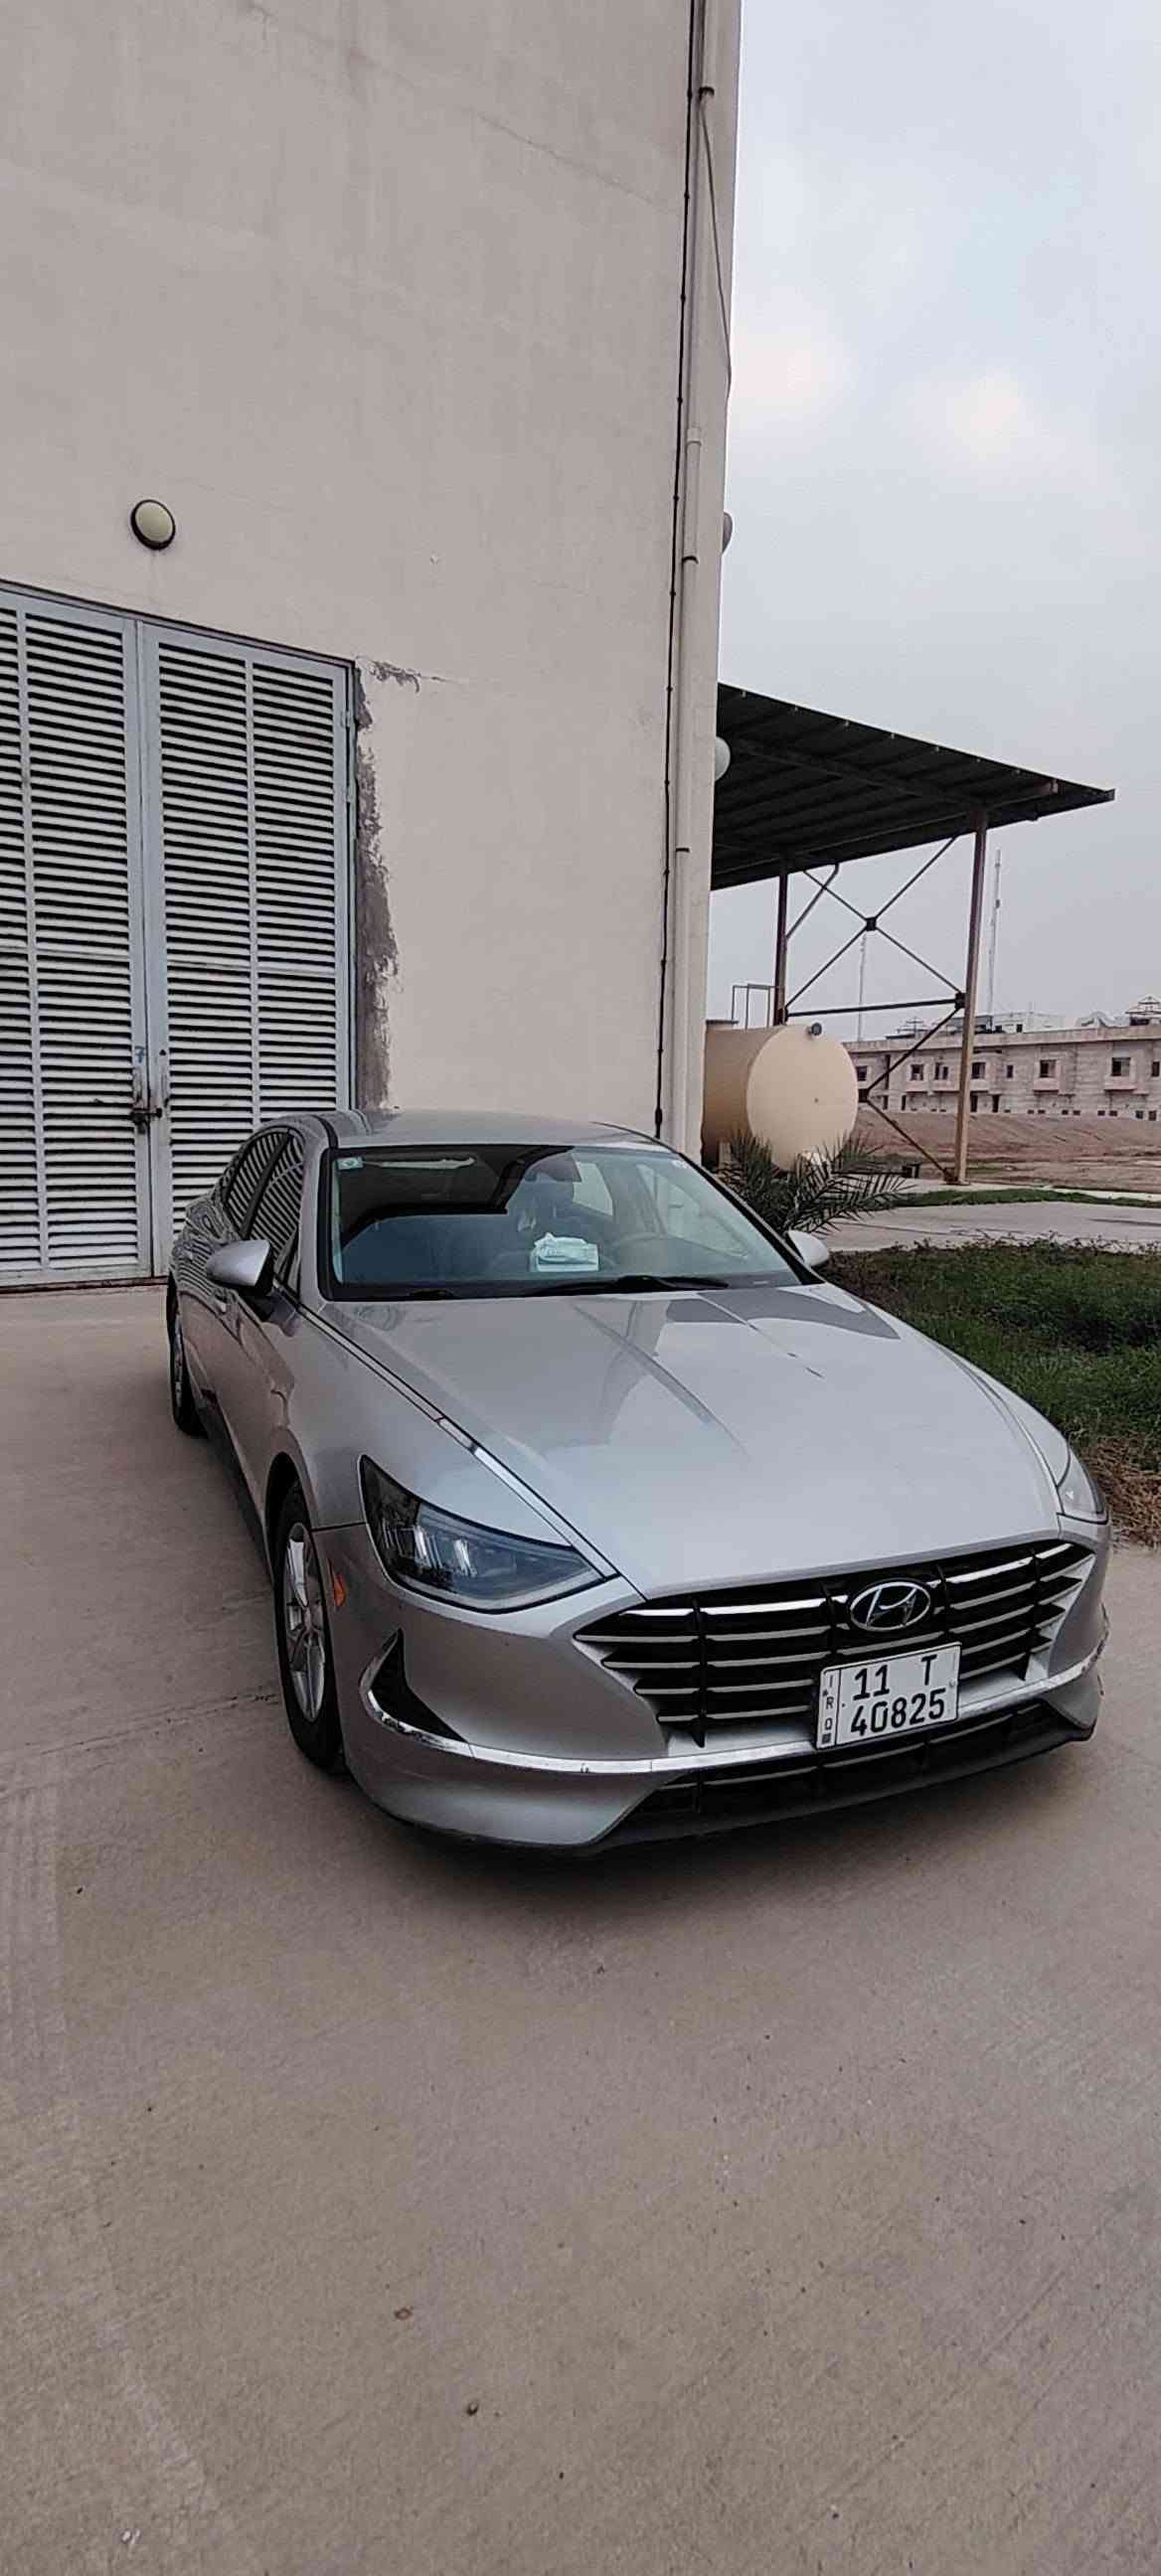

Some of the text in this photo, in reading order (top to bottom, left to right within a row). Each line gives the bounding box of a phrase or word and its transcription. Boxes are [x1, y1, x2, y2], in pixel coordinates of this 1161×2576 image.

[852, 1654, 937, 1700] 11 T
[850, 1688, 946, 1736] 40825
